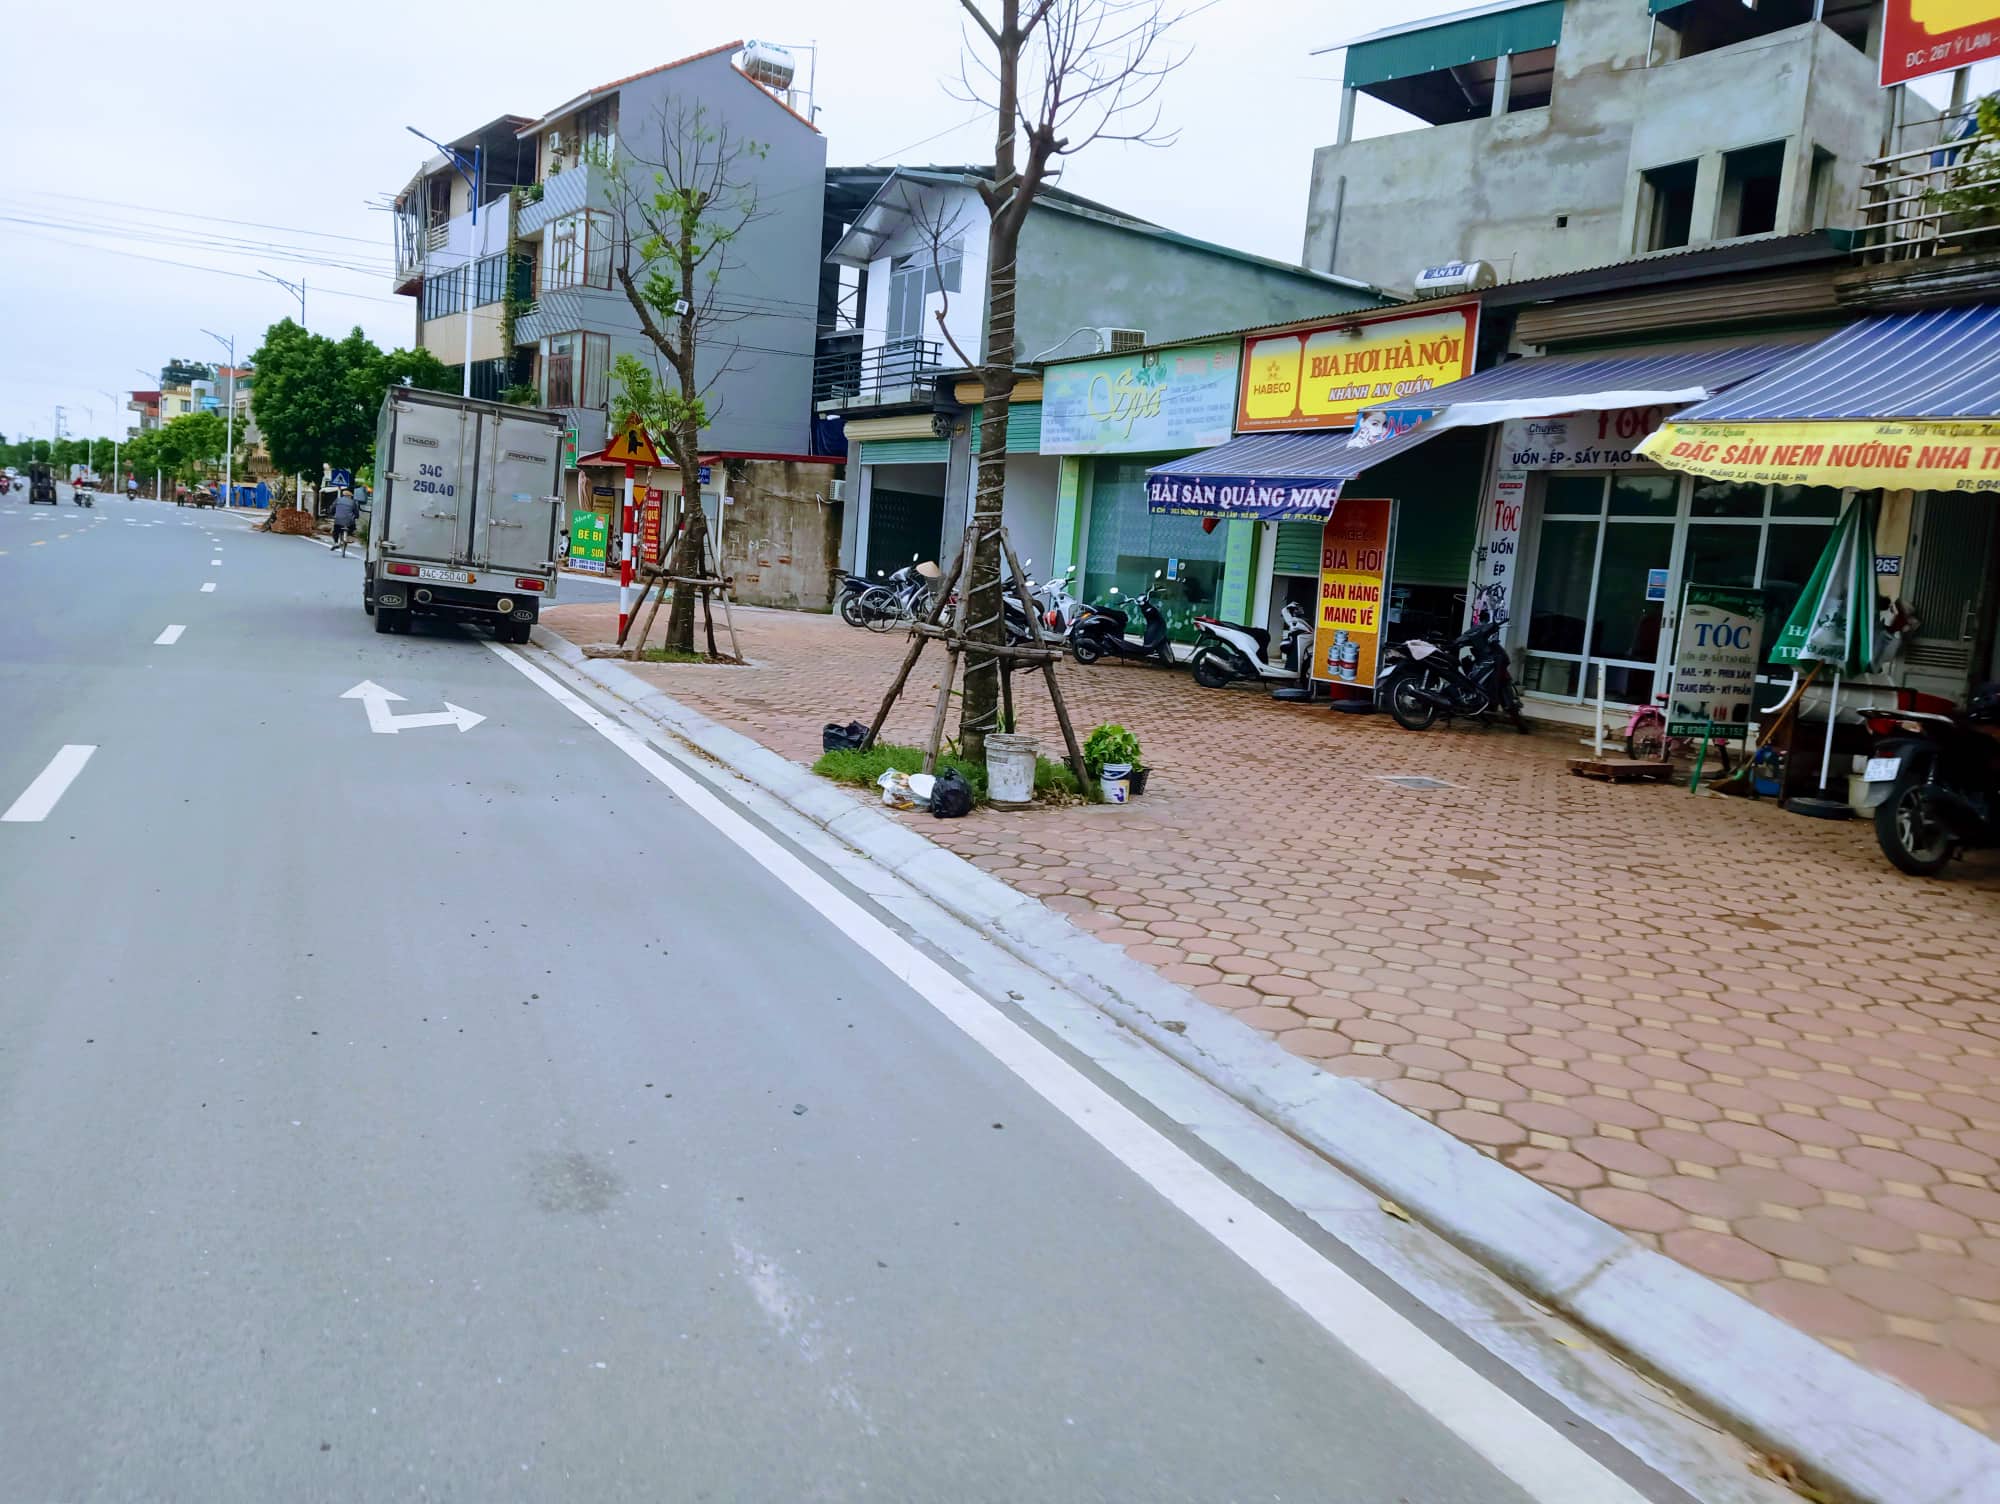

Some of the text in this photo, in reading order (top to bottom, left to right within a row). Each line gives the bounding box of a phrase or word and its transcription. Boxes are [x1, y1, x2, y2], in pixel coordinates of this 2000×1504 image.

[1310, 353, 1342, 378] BIA
[1383, 338, 1415, 371] HÀ
[1416, 334, 1462, 371] NỘI
[1253, 382, 1292, 395] HABECO
[1328, 381, 1370, 402] KHÁNH
[1372, 382, 1393, 399] AN
[407, 436, 436, 448] THACO
[1512, 447, 1540, 465] UỐN
[1549, 449, 1565, 464] ÉP
[1574, 446, 1601, 464] SẤY
[1604, 450, 1632, 467] TẠO
[1670, 439, 1719, 463] ĐẶC
[1720, 438, 1769, 465] SẢN
[1770, 443, 1825, 467] NEM
[1825, 439, 1913, 469] NƯỚNG
[1915, 445, 1972, 470] NHA
[419, 463, 442, 478] 34C
[413, 479, 454, 497] 250.40
[1151, 476, 1179, 502] HẢI
[1181, 477, 1217, 504] SẢN
[1220, 479, 1285, 509] QUẢNG
[1491, 537, 1515, 555] UỐN
[1322, 549, 1349, 570] BIA
[1875, 558, 1899, 573] 265
[1493, 562, 1507, 577] ÉP
[383, 595, 399, 604] KIA
[1322, 580, 1346, 600] BÁN
[515, 609, 531, 619] KIA
[1323, 605, 1357, 625] MANG
[1694, 617, 1753, 650] TÓC
